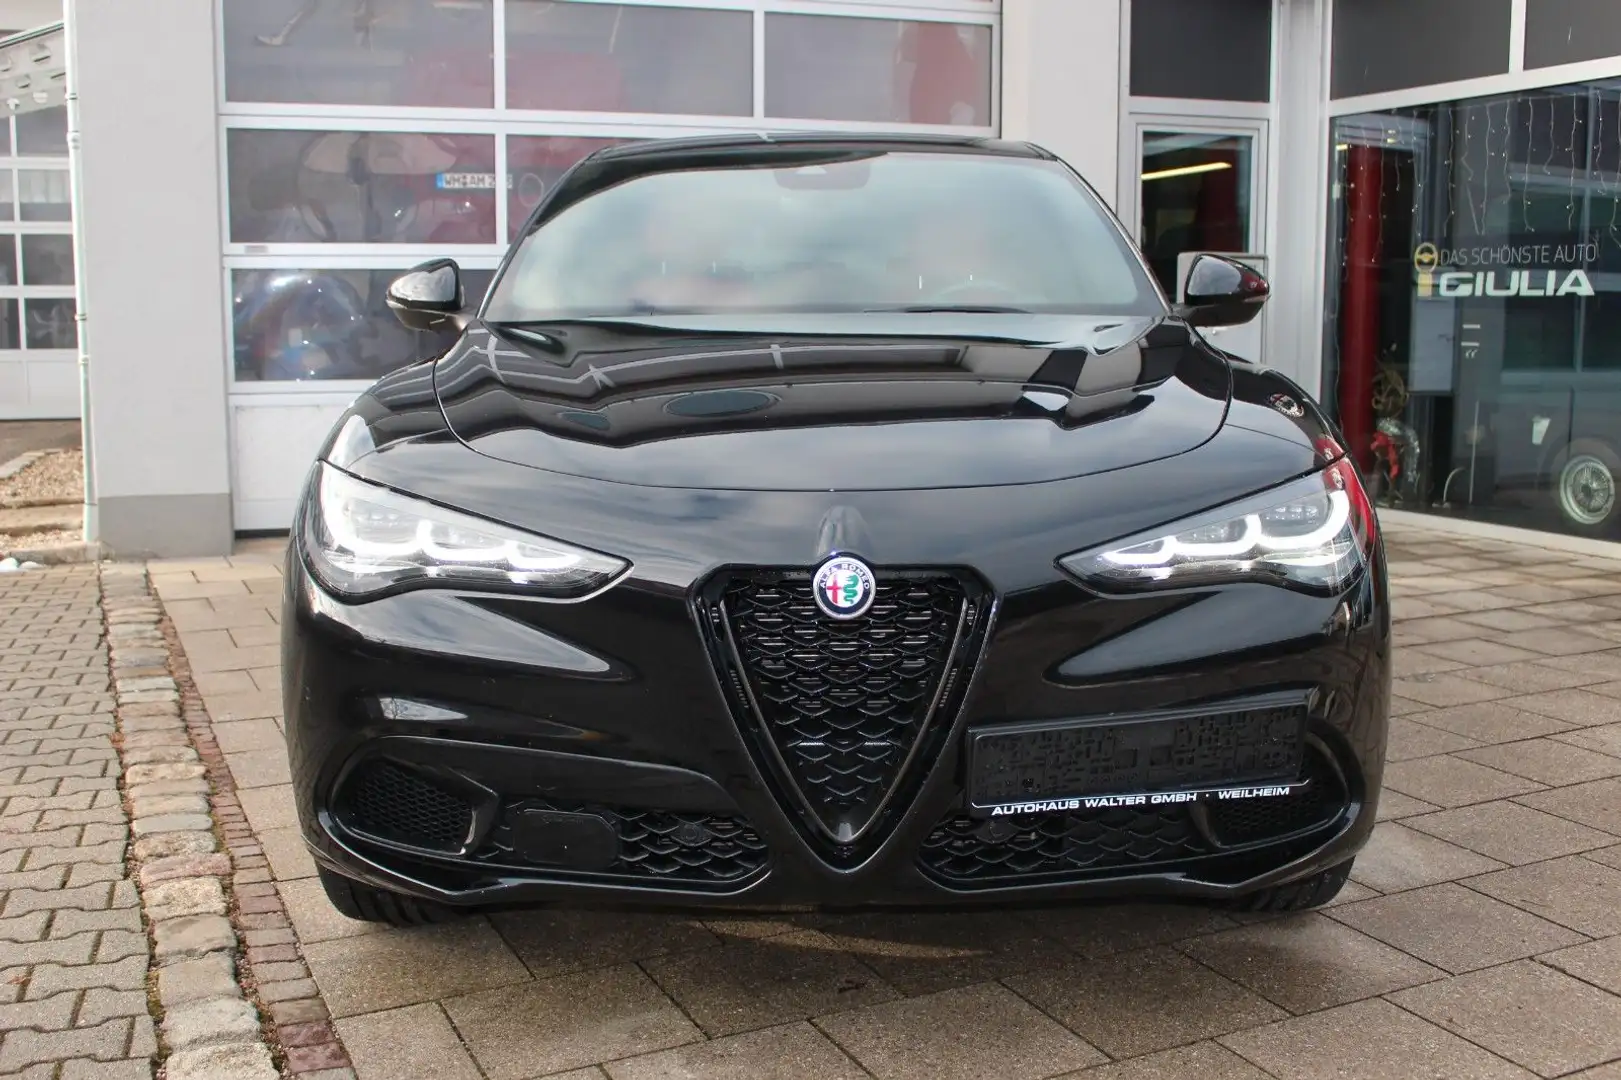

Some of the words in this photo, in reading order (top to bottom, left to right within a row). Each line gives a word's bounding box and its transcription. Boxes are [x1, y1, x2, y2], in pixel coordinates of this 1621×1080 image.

[1440, 249, 1468, 266] DAS
[1471, 245, 1549, 265] SCHÖNSTE
[1553, 243, 1596, 263] AUTO
[1439, 269, 1595, 297] GIULIA
[820, 564, 840, 589] ALFA
[841, 563, 870, 590] ROMEO
[991, 800, 1080, 816] AUTOHAUS
[1085, 796, 1146, 808] WALTER
[1151, 792, 1197, 804] GMBH
[1218, 787, 1290, 800] WEILHEIM
